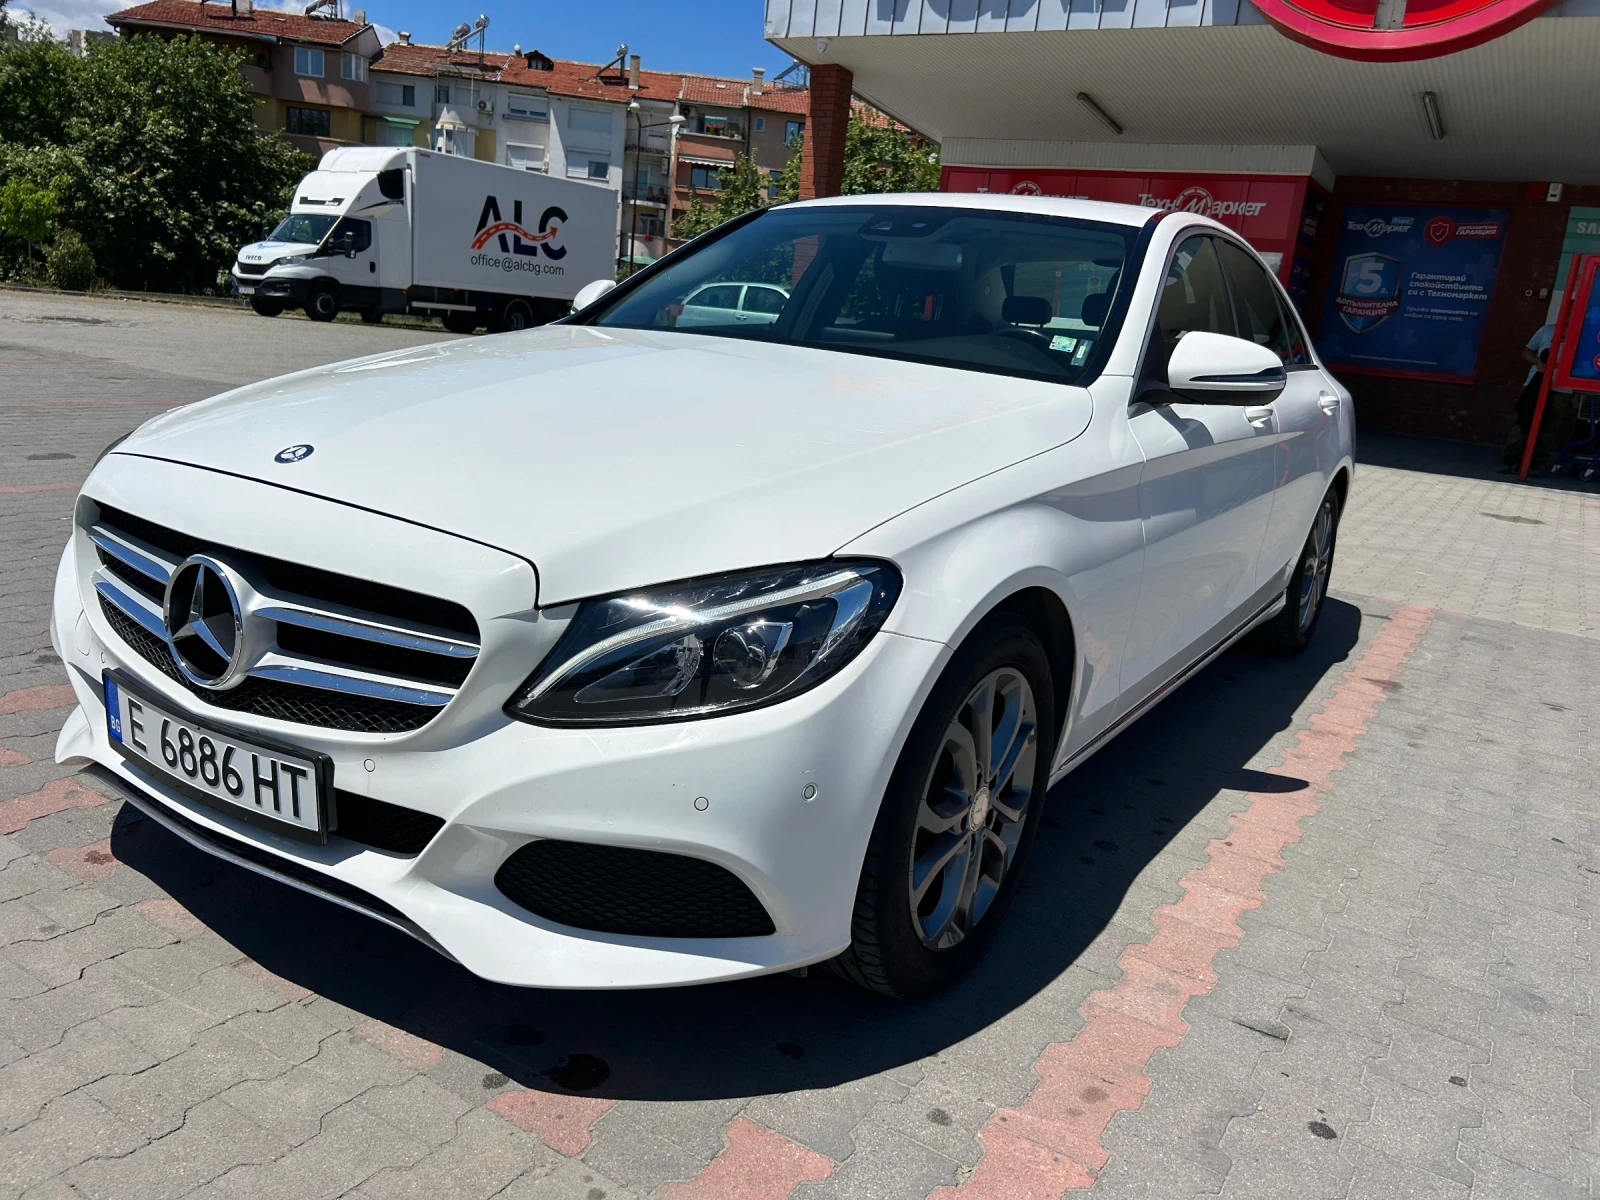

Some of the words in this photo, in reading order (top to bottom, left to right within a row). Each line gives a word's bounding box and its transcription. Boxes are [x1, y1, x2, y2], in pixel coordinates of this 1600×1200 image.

[473, 195, 569, 261] ALC
[470, 253, 565, 276] office@alcbg.com
[1355, 262, 1384, 293] 5
[1411, 272, 1466, 281] Гарантирай
[1409, 281, 1484, 291] спокойствието
[1335, 296, 1398, 308] ДОПЪЛНИТЕЛНА
[1427, 290, 1487, 300] Техномаркет
[1342, 305, 1387, 316] ГАРАНЦИЯ
[111, 715, 121, 733] BG
[128, 697, 148, 753] E
[161, 718, 244, 797] 6886
[251, 753, 307, 818] HT
